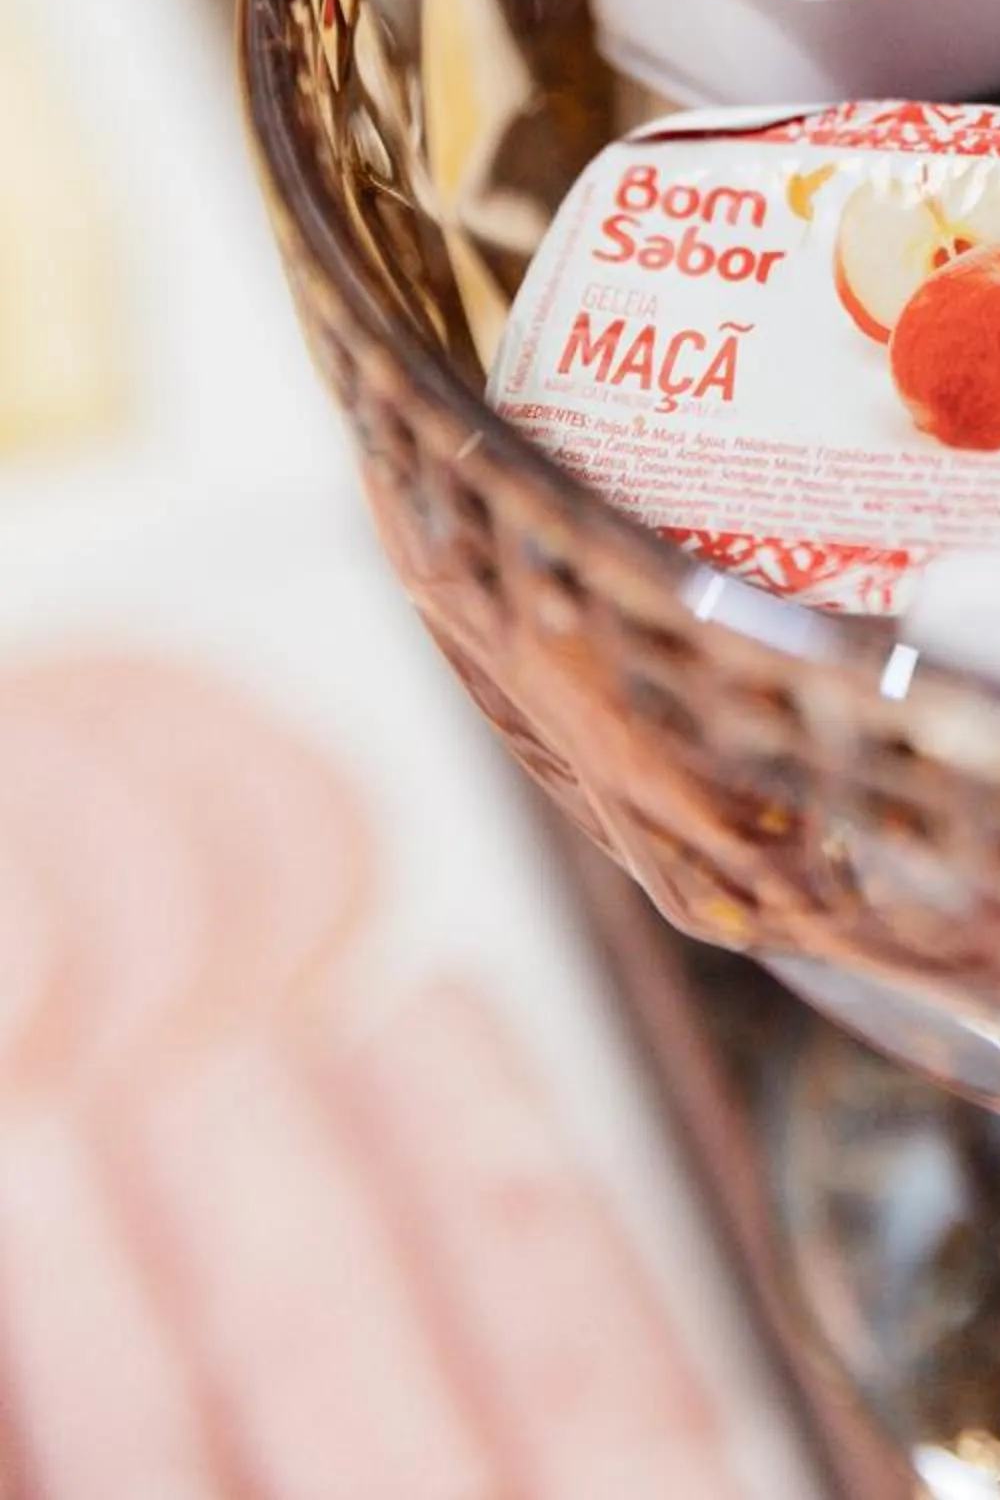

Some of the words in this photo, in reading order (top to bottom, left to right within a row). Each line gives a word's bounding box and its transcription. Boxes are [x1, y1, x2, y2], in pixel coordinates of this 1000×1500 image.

[615, 164, 767, 229] Bom
[592, 214, 786, 284] Sabor
[583, 282, 658, 318] GELEIA
[558, 311, 755, 414] MAÇÃ
